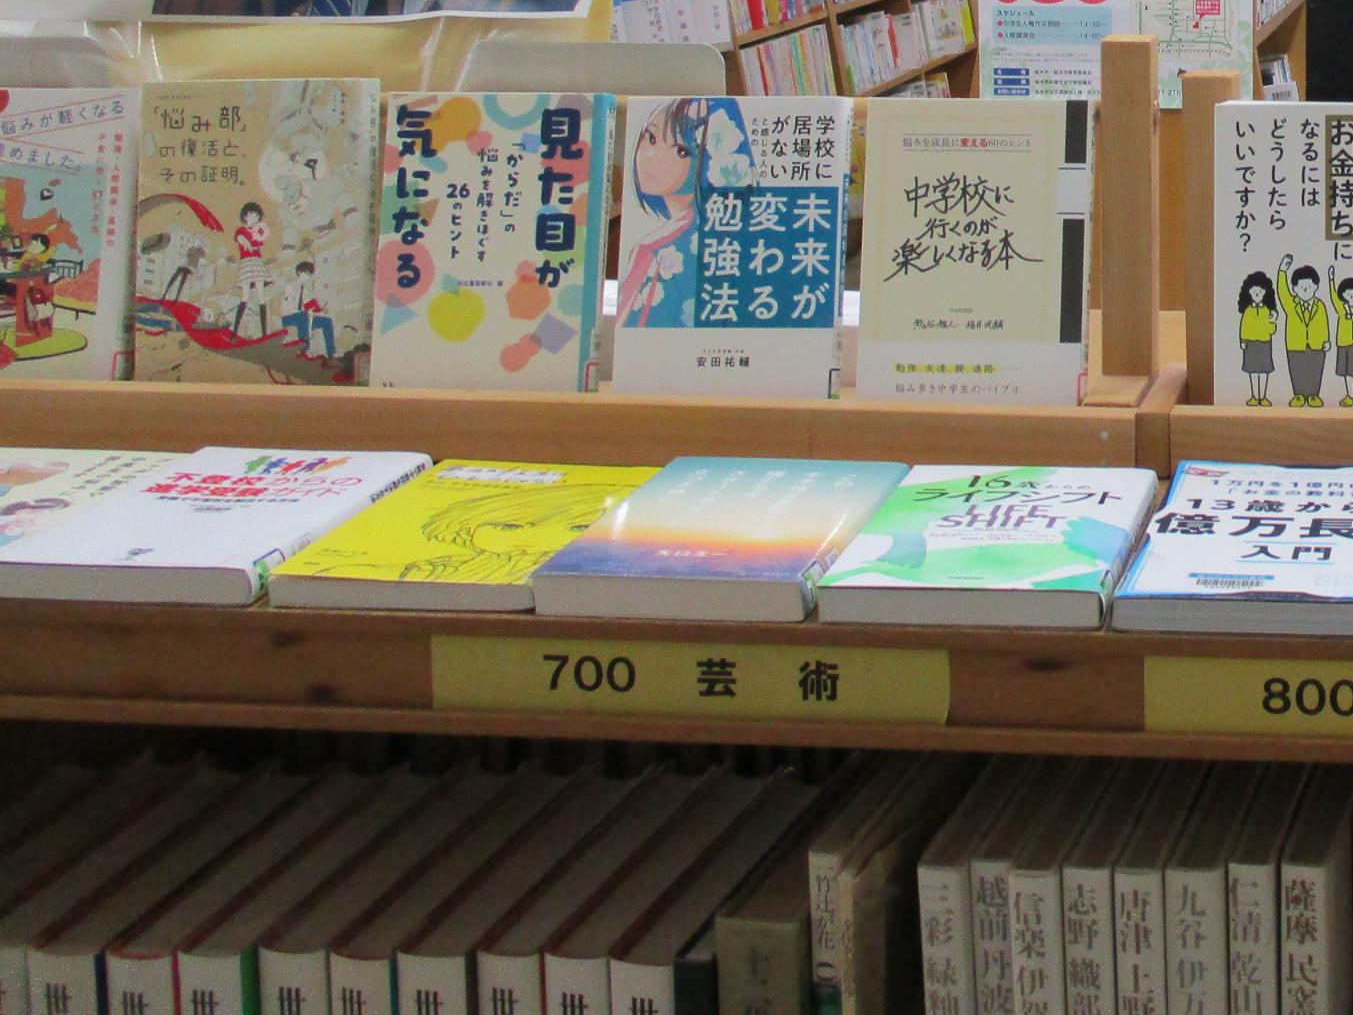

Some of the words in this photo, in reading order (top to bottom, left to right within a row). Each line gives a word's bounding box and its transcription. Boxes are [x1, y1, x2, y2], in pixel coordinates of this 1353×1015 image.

[154, 104, 247, 134] 「悩み部」
[160, 139, 247, 159] の復活と、
[751, 118, 759, 147] ための
[770, 115, 790, 179] がない
[790, 115, 812, 181] 居場所
[815, 115, 835, 180] 学校に
[902, 137, 1032, 149] 悩みを成長に変える60のヒント
[0, 143, 83, 172] めました。
[160, 168, 245, 186] その証明。
[500, 142, 527, 233] 「からだ」の
[1235, 121, 1256, 252] いいですか?
[1268, 118, 1288, 230] どうしたら
[1300, 119, 1321, 207] なるには
[392, 104, 437, 288] 気になる
[446, 183, 470, 260] 26のヒント
[476, 148, 499, 262] 悩みを解きほぐす
[535, 108, 584, 288] 見た目が
[904, 172, 1015, 217] 中学校に
[700, 193, 742, 322] 勉強法
[748, 193, 788, 319] 変わる
[790, 193, 832, 319] 未来が
[884, 229, 1044, 282] 楽しくなる本
[916, 215, 998, 241] 行くのが
[913, 488, 1123, 505] ライフシフト
[965, 475, 1091, 490] 16歳からの
[965, 505, 1051, 518] LIFE
[936, 515, 1068, 529] SHIFT
[1241, 545, 1332, 561] 入門
[542, 654, 637, 693] 700
[1067, 884, 1100, 951] 志野
[1120, 889, 1152, 956] 唐津
[1176, 884, 1207, 950] 九谷
[1229, 877, 1261, 944] 仁清
